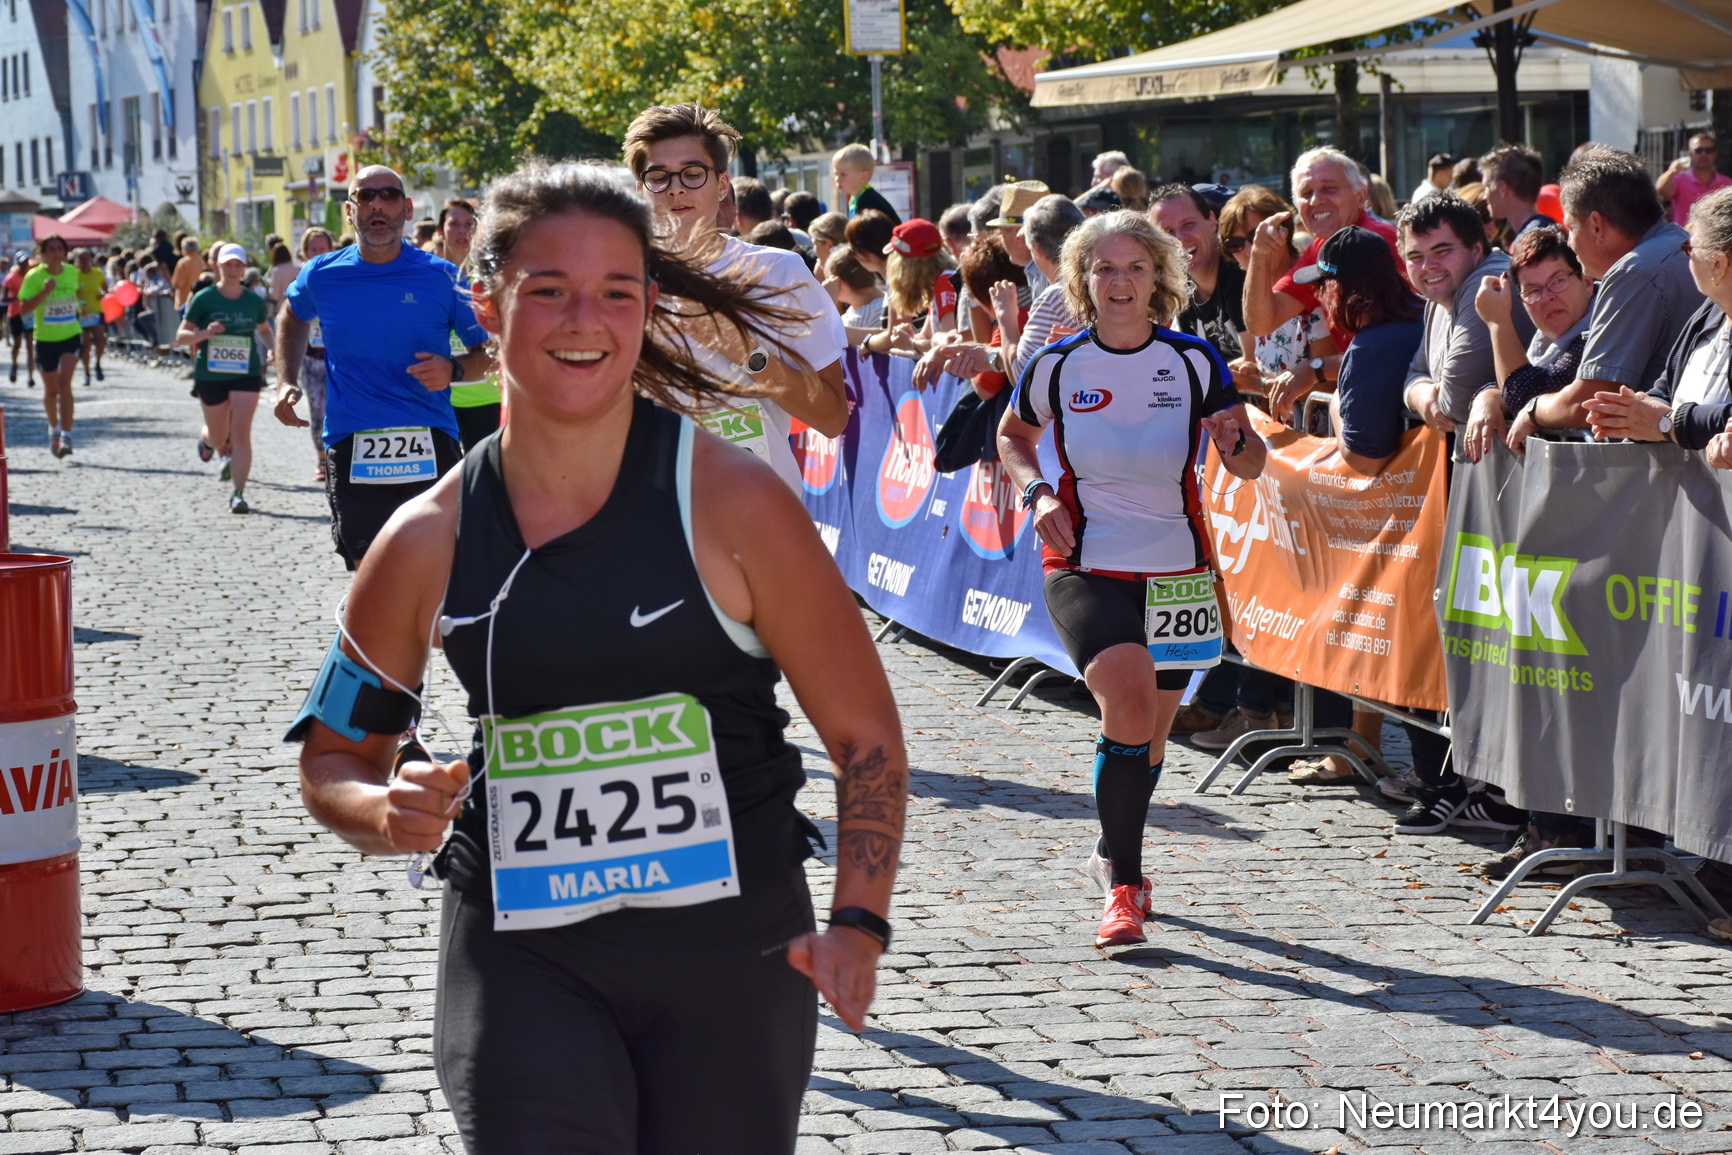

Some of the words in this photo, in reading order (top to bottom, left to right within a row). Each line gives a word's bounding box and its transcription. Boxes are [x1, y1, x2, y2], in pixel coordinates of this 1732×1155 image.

[213, 348, 245, 360] 2066
[1072, 390, 1100, 404] tkn
[363, 437, 424, 459] 2224
[367, 464, 420, 476] THOMAS
[1308, 467, 1346, 489] Neumarkts
[1373, 492, 1390, 508] und
[968, 510, 996, 530] SPORTS
[868, 552, 888, 587] GET
[881, 558, 916, 597] MOVIN'
[962, 588, 989, 627] GET
[978, 593, 1032, 637] MOVIN'
[1239, 595, 1306, 641] Agentur
[1606, 574, 1702, 633] OFFIE
[1154, 604, 1218, 638] 2809
[1165, 643, 1201, 660] Helga
[1326, 629, 1339, 646] tel:
[1373, 637, 1392, 657] 897
[1442, 627, 1508, 666] inspired
[1510, 661, 1594, 696] oncepts
[500, 709, 684, 760] BOCK
[700, 772, 711, 784] D
[511, 771, 697, 853] 2425
[548, 860, 671, 900] MARIA
